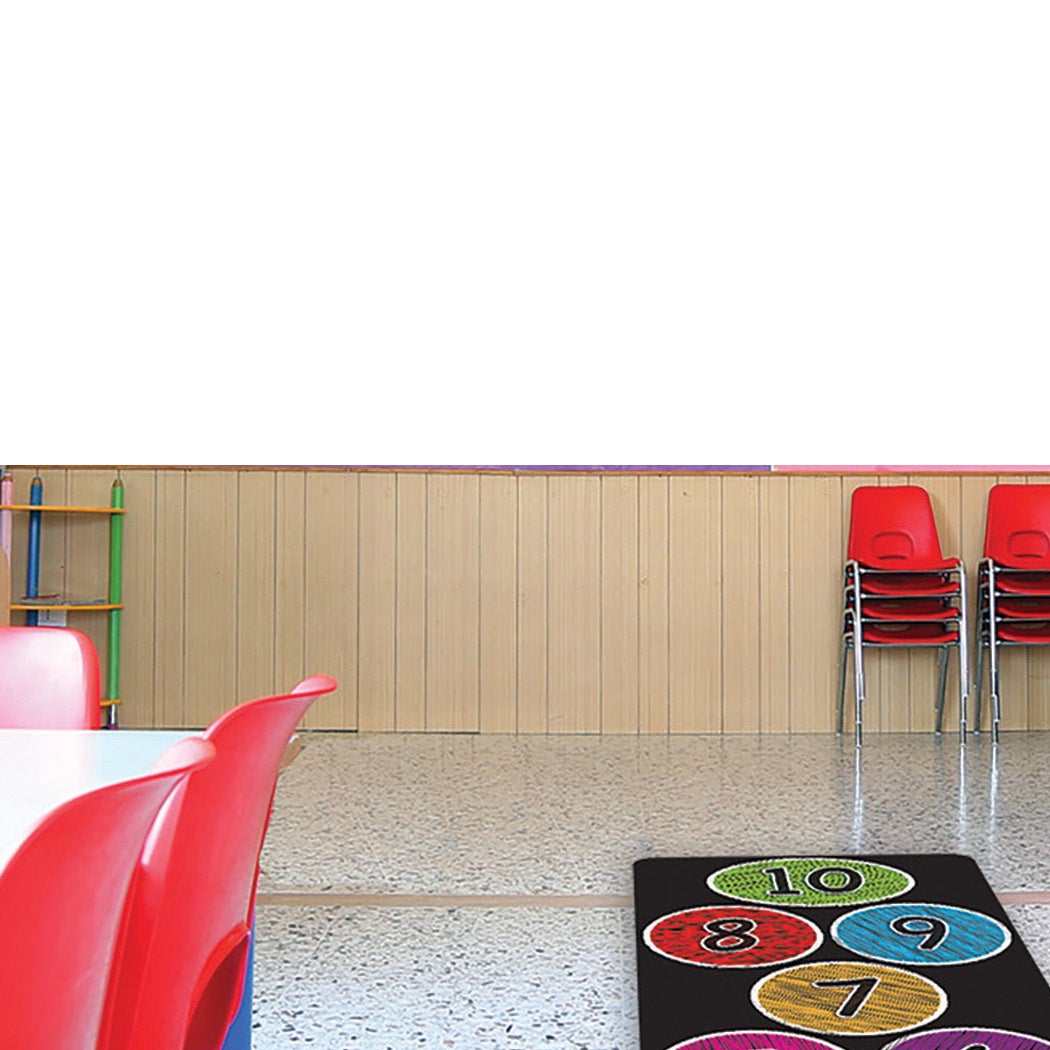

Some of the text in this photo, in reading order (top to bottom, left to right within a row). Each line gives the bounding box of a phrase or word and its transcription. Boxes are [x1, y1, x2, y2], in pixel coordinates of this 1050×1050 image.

[764, 866, 865, 896] 10
[700, 917, 758, 953] 8
[889, 915, 949, 951] 9
[813, 977, 882, 1018] 7
